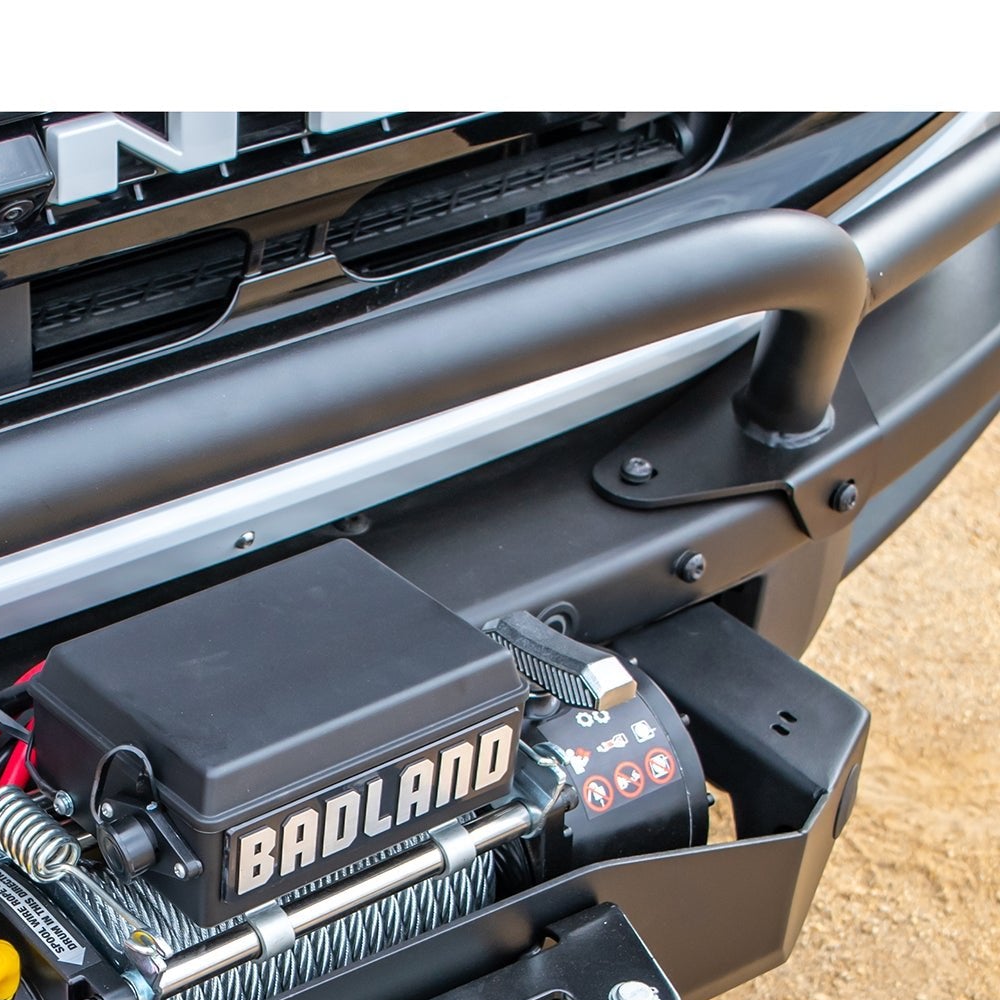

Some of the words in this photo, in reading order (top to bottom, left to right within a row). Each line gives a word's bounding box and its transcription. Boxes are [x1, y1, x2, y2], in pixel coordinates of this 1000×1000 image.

[238, 725, 513, 895] BADLAND
[17, 905, 41, 928] WIRE
[24, 897, 45, 916] THIS
[41, 915, 55, 926] IN
[38, 926, 65, 954] SPOOL
[51, 925, 78, 951] DRUM
